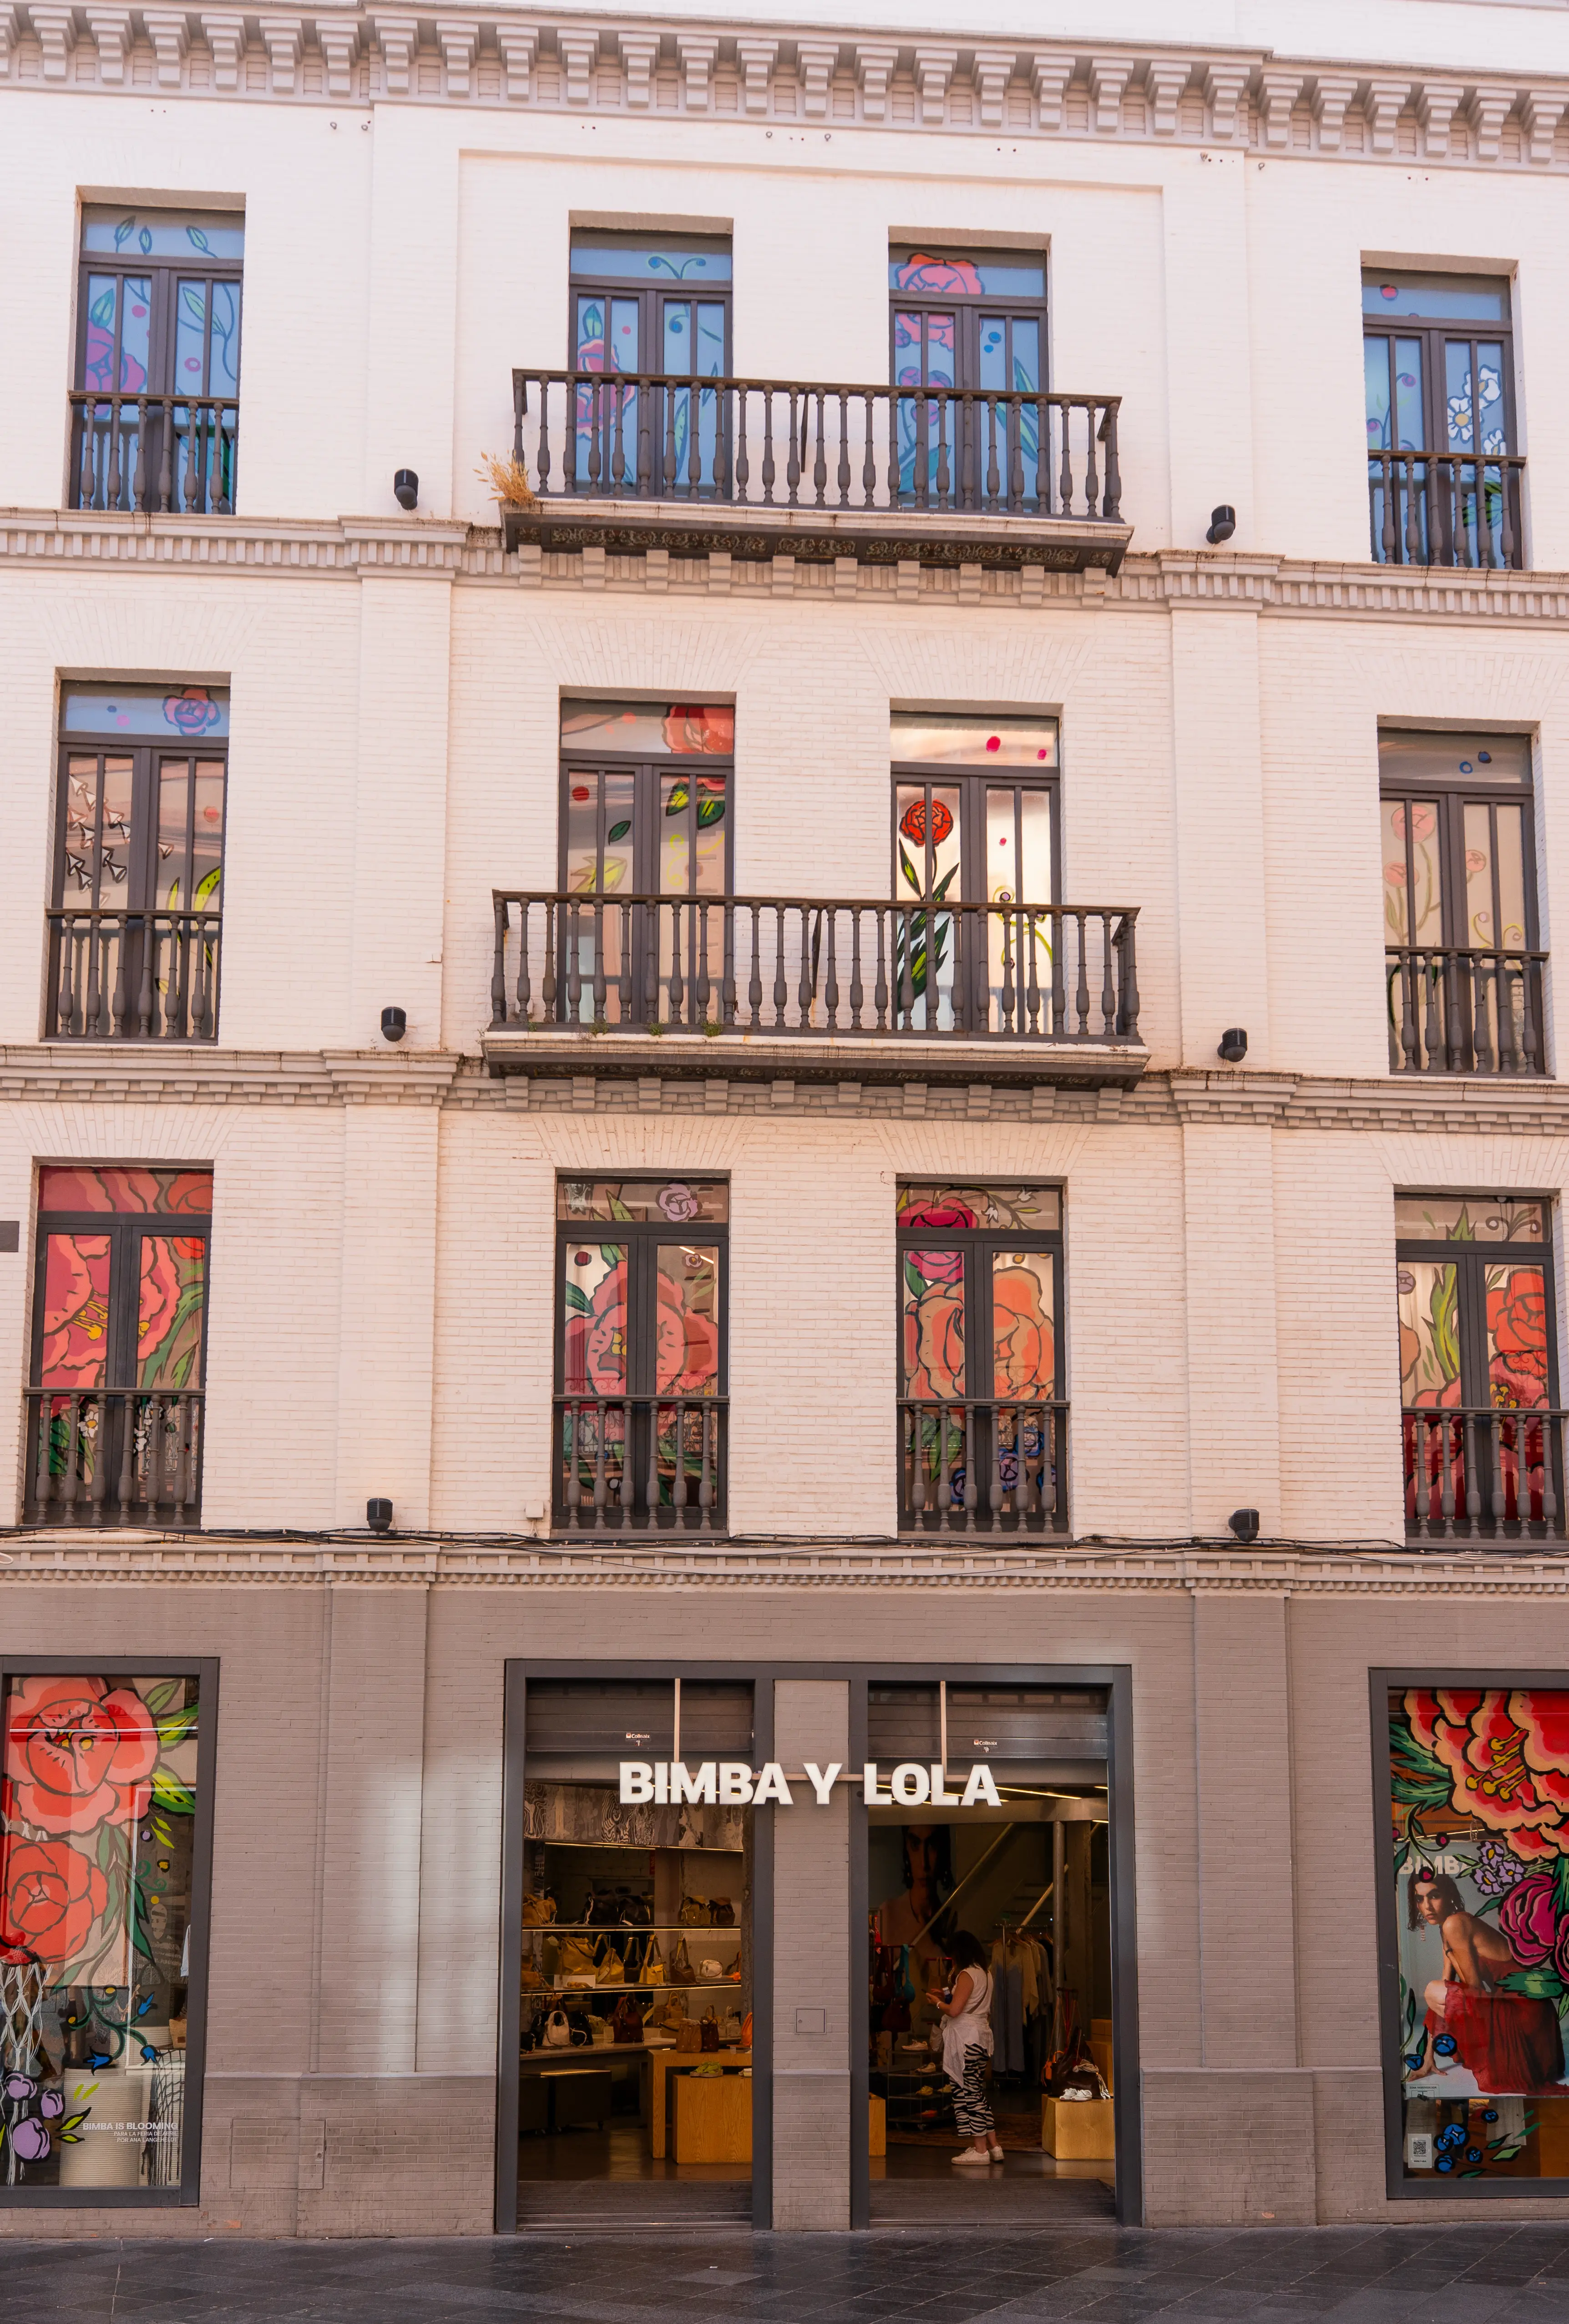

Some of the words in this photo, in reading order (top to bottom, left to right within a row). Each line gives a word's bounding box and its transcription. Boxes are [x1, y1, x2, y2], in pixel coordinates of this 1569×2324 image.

[619, 1762, 794, 1805] BIMBA
[802, 1762, 843, 1805] Y
[863, 1763, 1003, 1806] LOLA
[127, 2122, 178, 2130] BLOOMING
